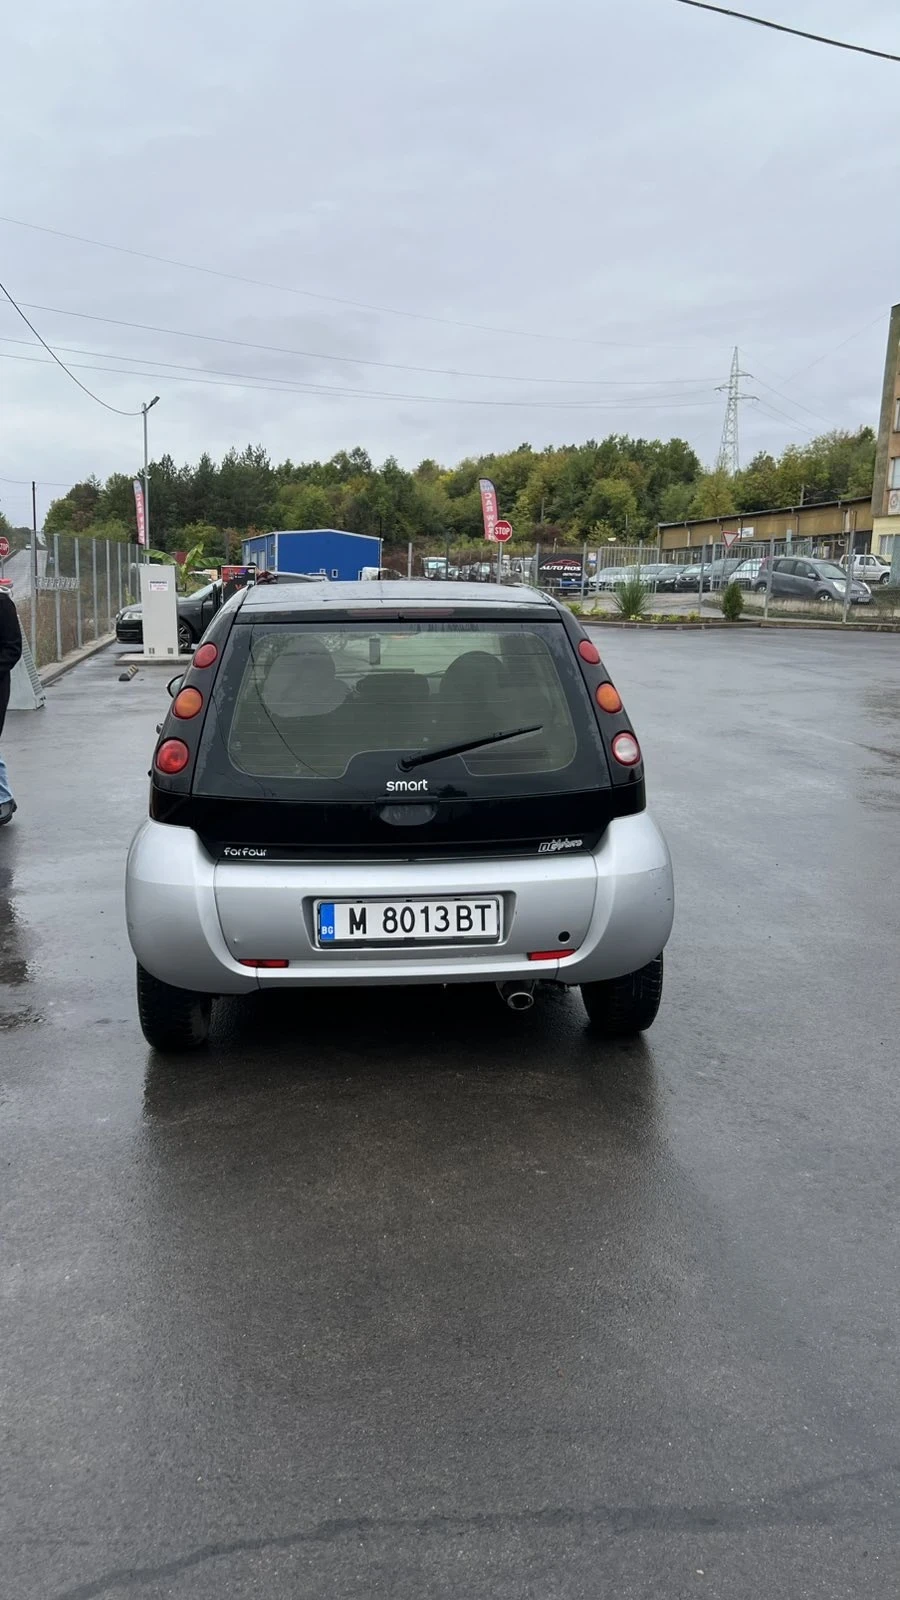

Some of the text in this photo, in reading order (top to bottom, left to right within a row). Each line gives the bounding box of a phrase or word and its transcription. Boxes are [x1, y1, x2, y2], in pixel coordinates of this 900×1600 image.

[494, 526, 511, 536] STOP
[0, 542, 9, 551] TOP
[386, 779, 429, 792] smart
[223, 847, 267, 857] forfour
[349, 907, 367, 935] M
[321, 926, 334, 935] BG
